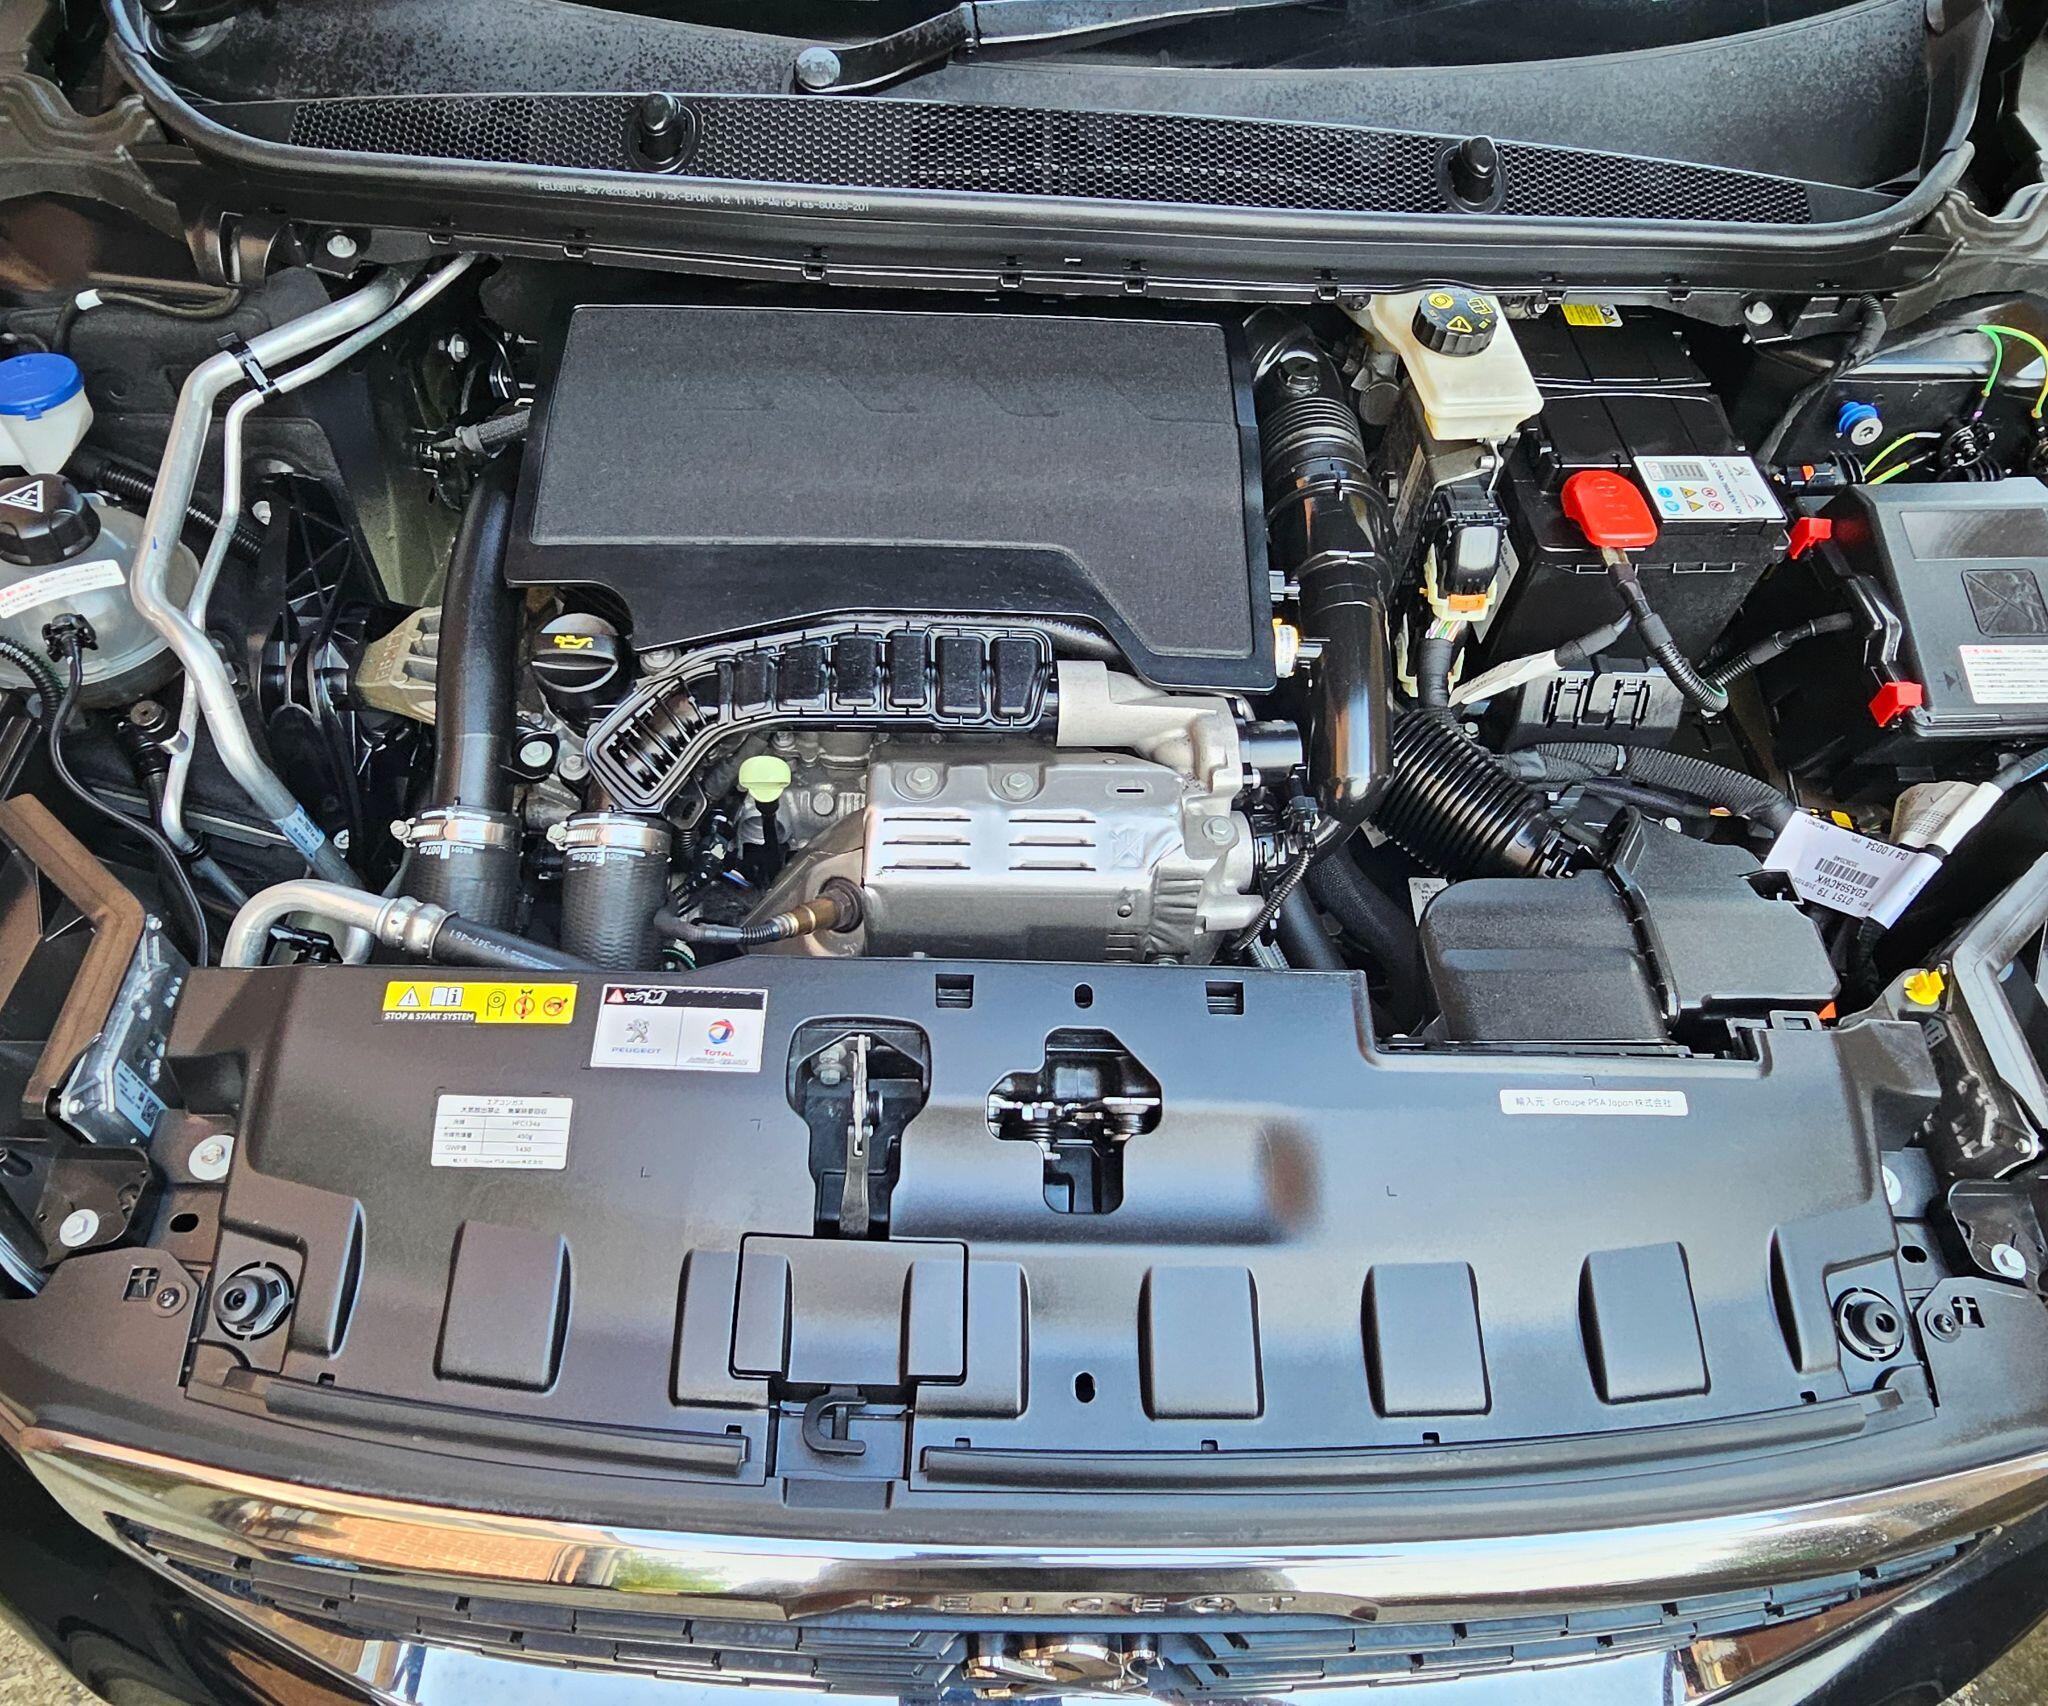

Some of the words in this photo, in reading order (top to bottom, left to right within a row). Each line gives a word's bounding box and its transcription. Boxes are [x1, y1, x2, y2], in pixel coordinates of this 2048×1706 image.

[1865, 842, 1888, 855] 0034
[1895, 850, 1909, 861] 04
[1816, 887, 1829, 898] T9
[1832, 893, 1854, 906] 0151
[384, 1012, 408, 1021] STOP
[407, 1012, 415, 1020] &
[416, 1012, 442, 1021] START
[443, 1013, 475, 1022] SYSTEM
[703, 1048, 735, 1057] TOTAL
[1552, 1098, 1586, 1107] Groupe
[1587, 1098, 1606, 1106] PSA
